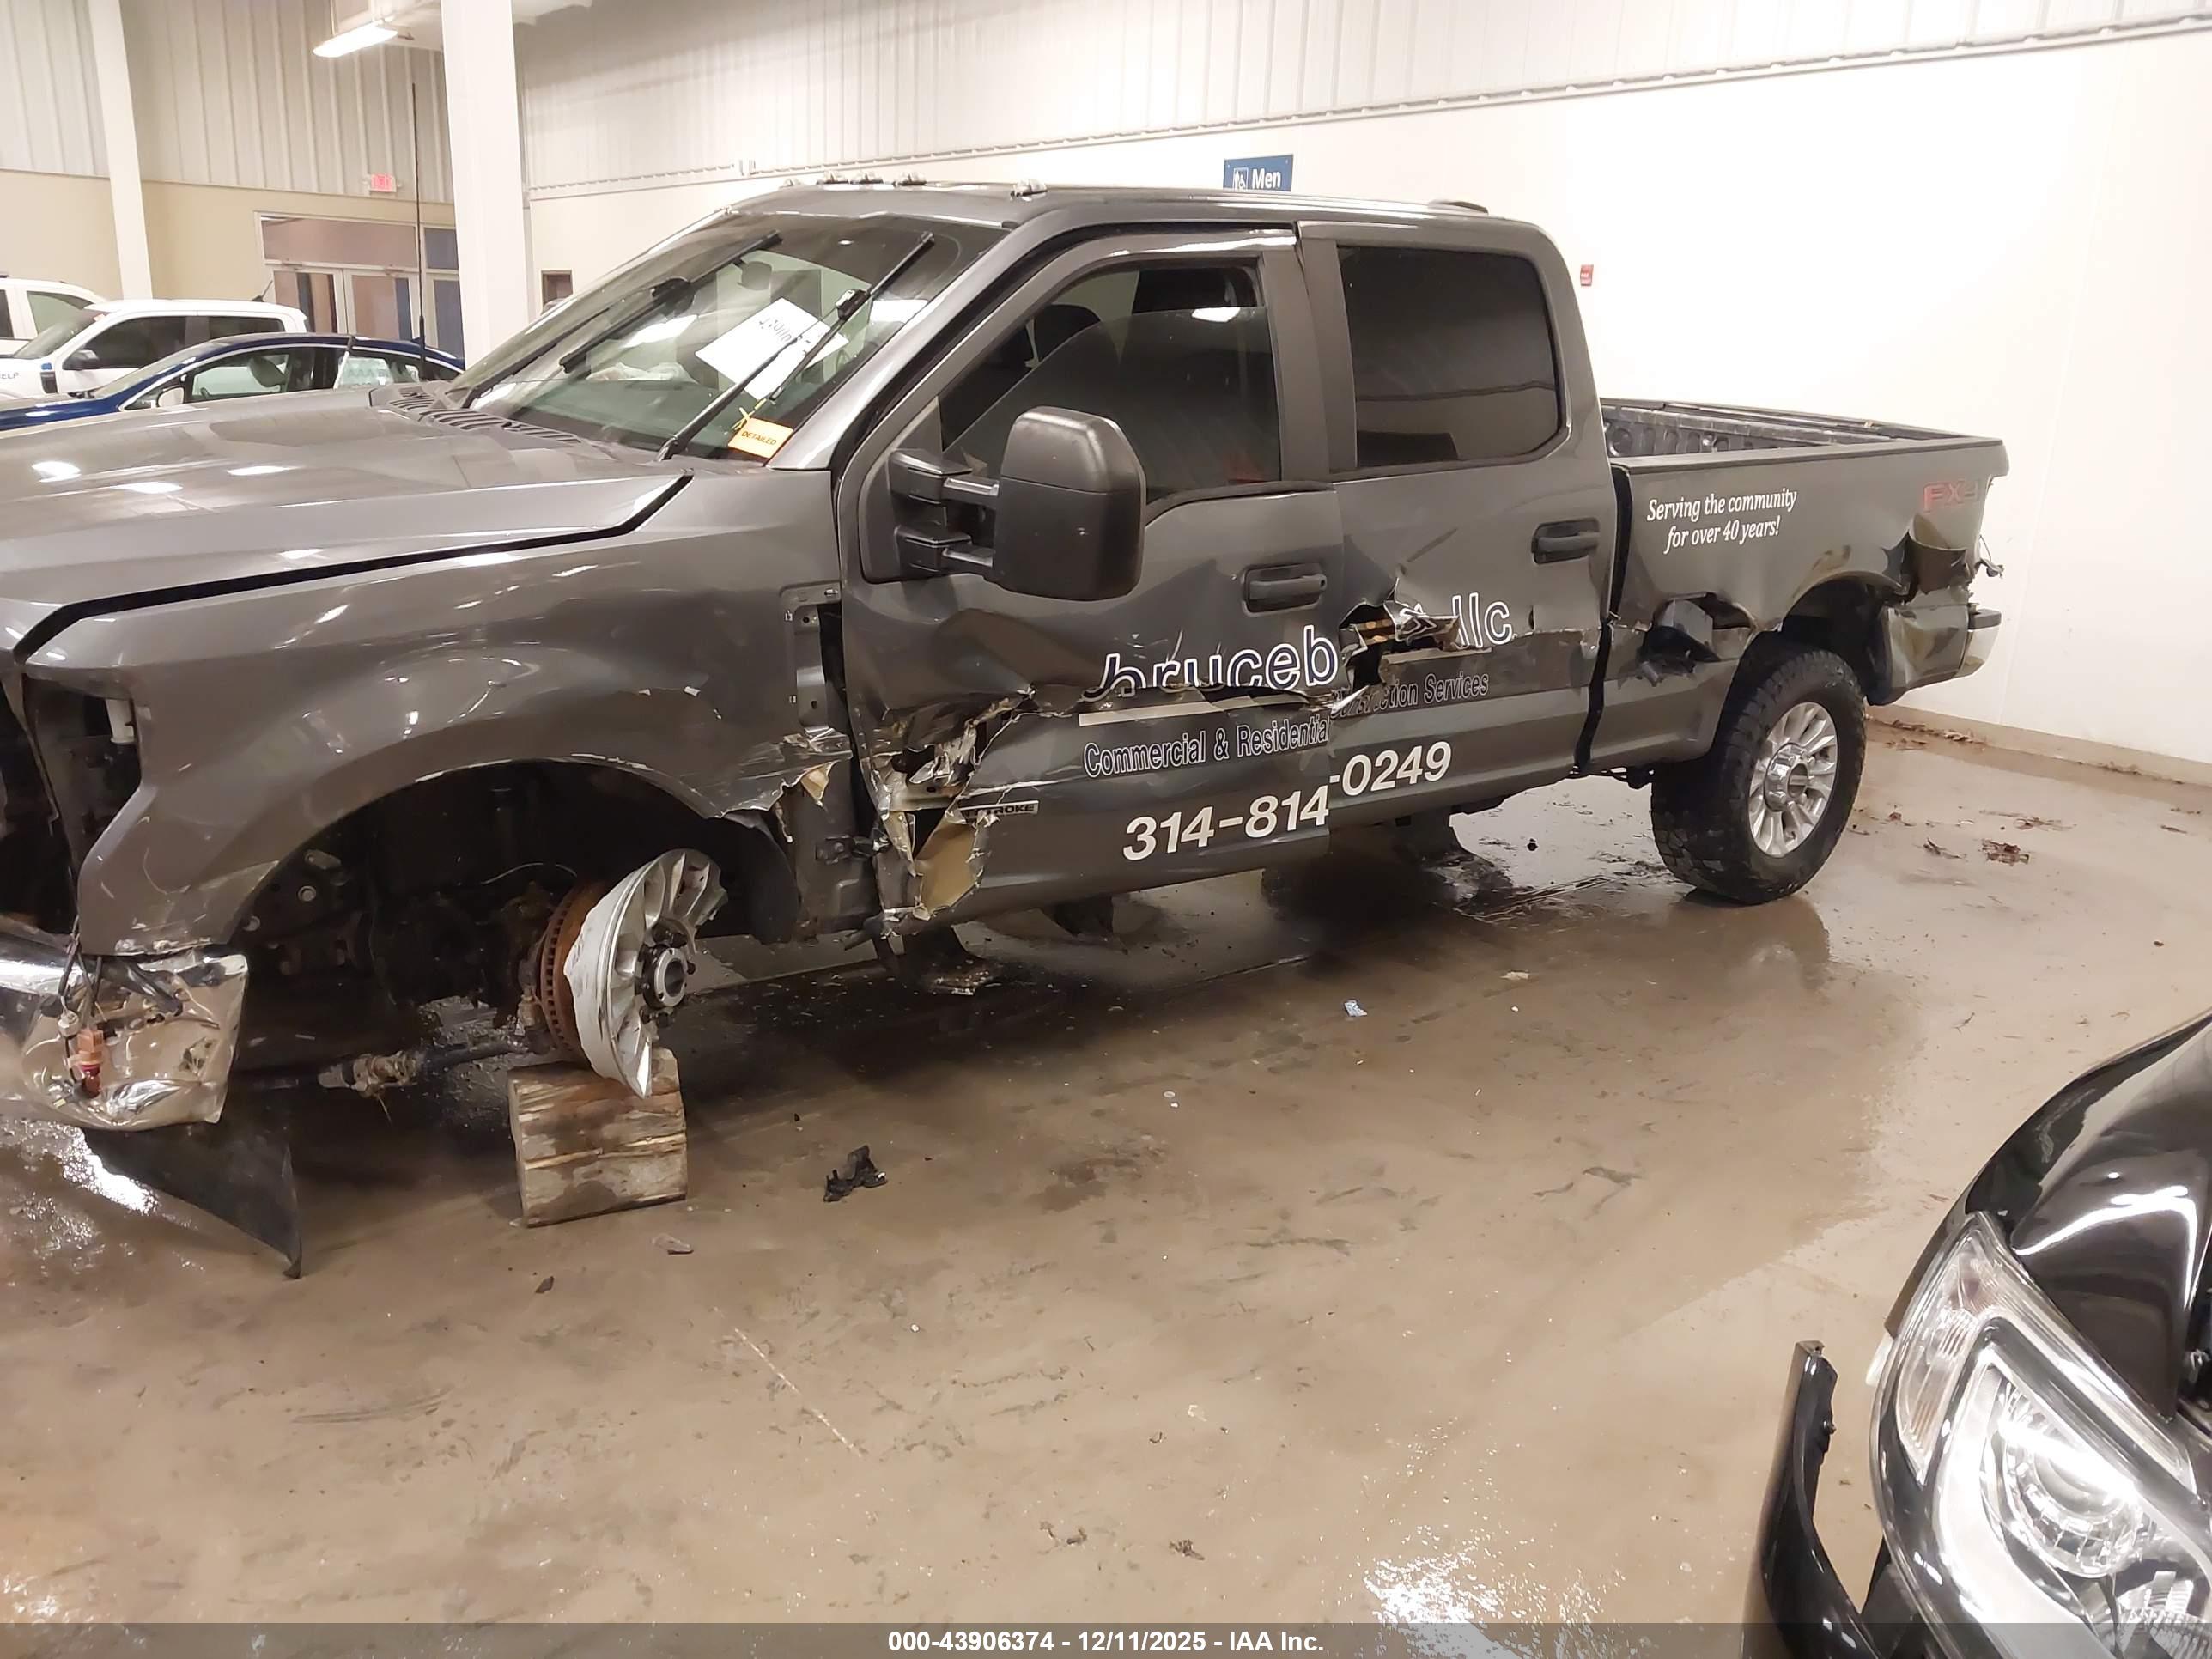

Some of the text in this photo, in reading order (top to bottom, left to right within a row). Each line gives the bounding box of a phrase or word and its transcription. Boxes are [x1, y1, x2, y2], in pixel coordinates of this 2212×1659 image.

[1251, 167, 1281, 189] Men
[741, 430, 777, 446] DETAILED
[1646, 488, 1797, 523] Serving the community
[1663, 515, 1781, 555] for over 40 years!
[1084, 731, 1206, 778] Commercial
[1213, 728, 1230, 761] &
[1424, 672, 1490, 704] Services
